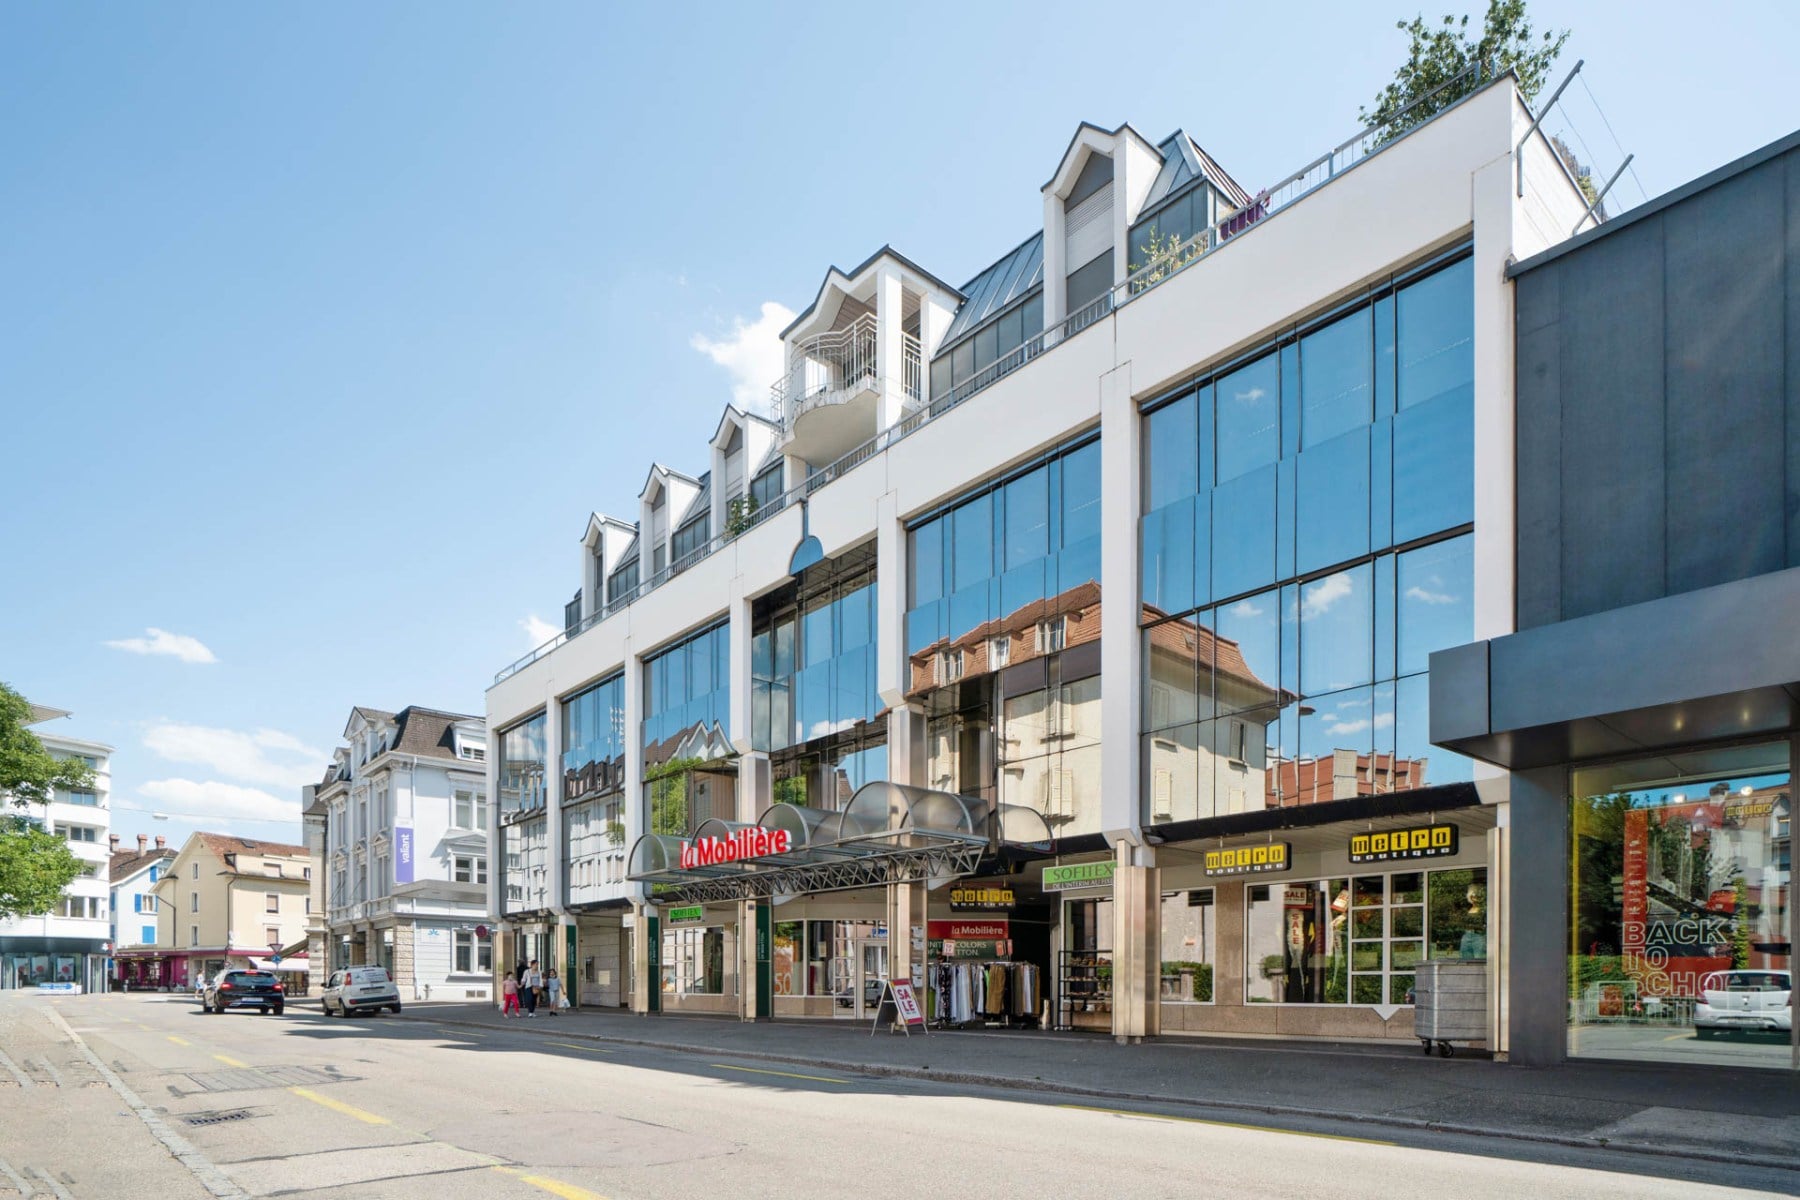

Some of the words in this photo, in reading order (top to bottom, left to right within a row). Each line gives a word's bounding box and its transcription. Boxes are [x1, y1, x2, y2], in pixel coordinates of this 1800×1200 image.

[400, 833, 410, 864] valiant
[680, 841, 695, 870] la
[698, 826, 790, 865] Mobilière
[1353, 828, 1450, 853] metro
[1207, 846, 1283, 868] metro
[1352, 848, 1450, 861] boutique
[1053, 864, 1112, 881] SOFITEX
[1206, 864, 1283, 875] boutique
[952, 926, 959, 934] la
[961, 926, 1003, 935] Mobilière
[1292, 913, 1300, 944] SALE
[1623, 919, 1727, 945] BACK
[1622, 946, 1669, 970] TO
[897, 989, 910, 999] SA
[1625, 971, 1731, 996] SCHO
[902, 1001, 915, 1011] LE
